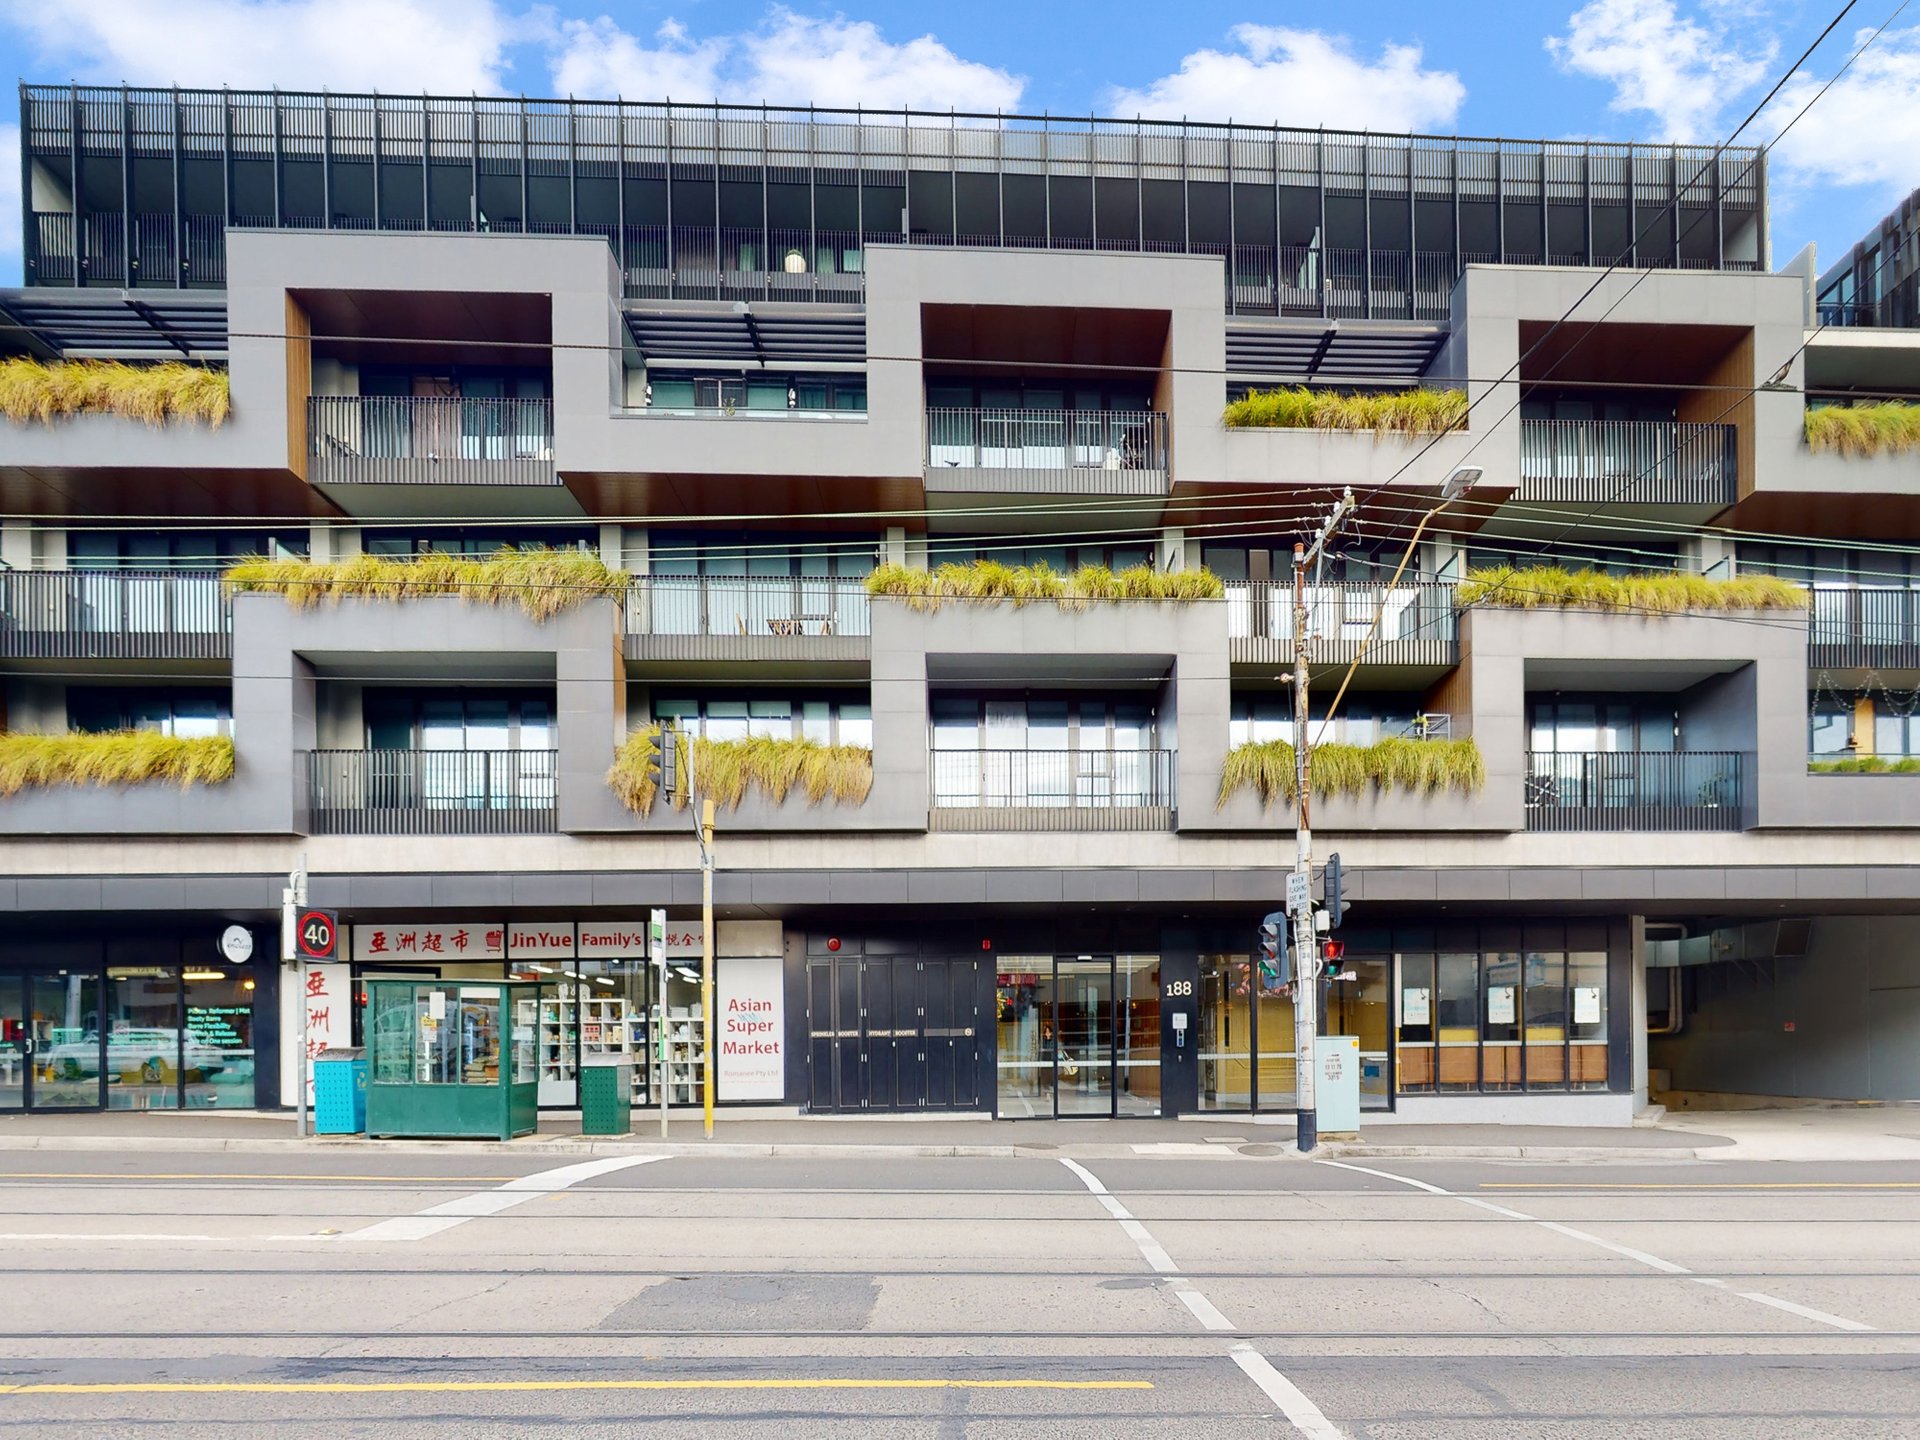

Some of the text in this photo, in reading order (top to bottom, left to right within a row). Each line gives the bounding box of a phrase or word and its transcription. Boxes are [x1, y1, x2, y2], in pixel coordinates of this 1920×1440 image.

[304, 925, 329, 945] 40
[510, 932, 572, 948] JinYue
[581, 933, 641, 949] Family's
[1166, 981, 1192, 996] 188
[728, 998, 772, 1012] Asian
[727, 1019, 774, 1035] Super
[723, 1041, 780, 1054] Market
